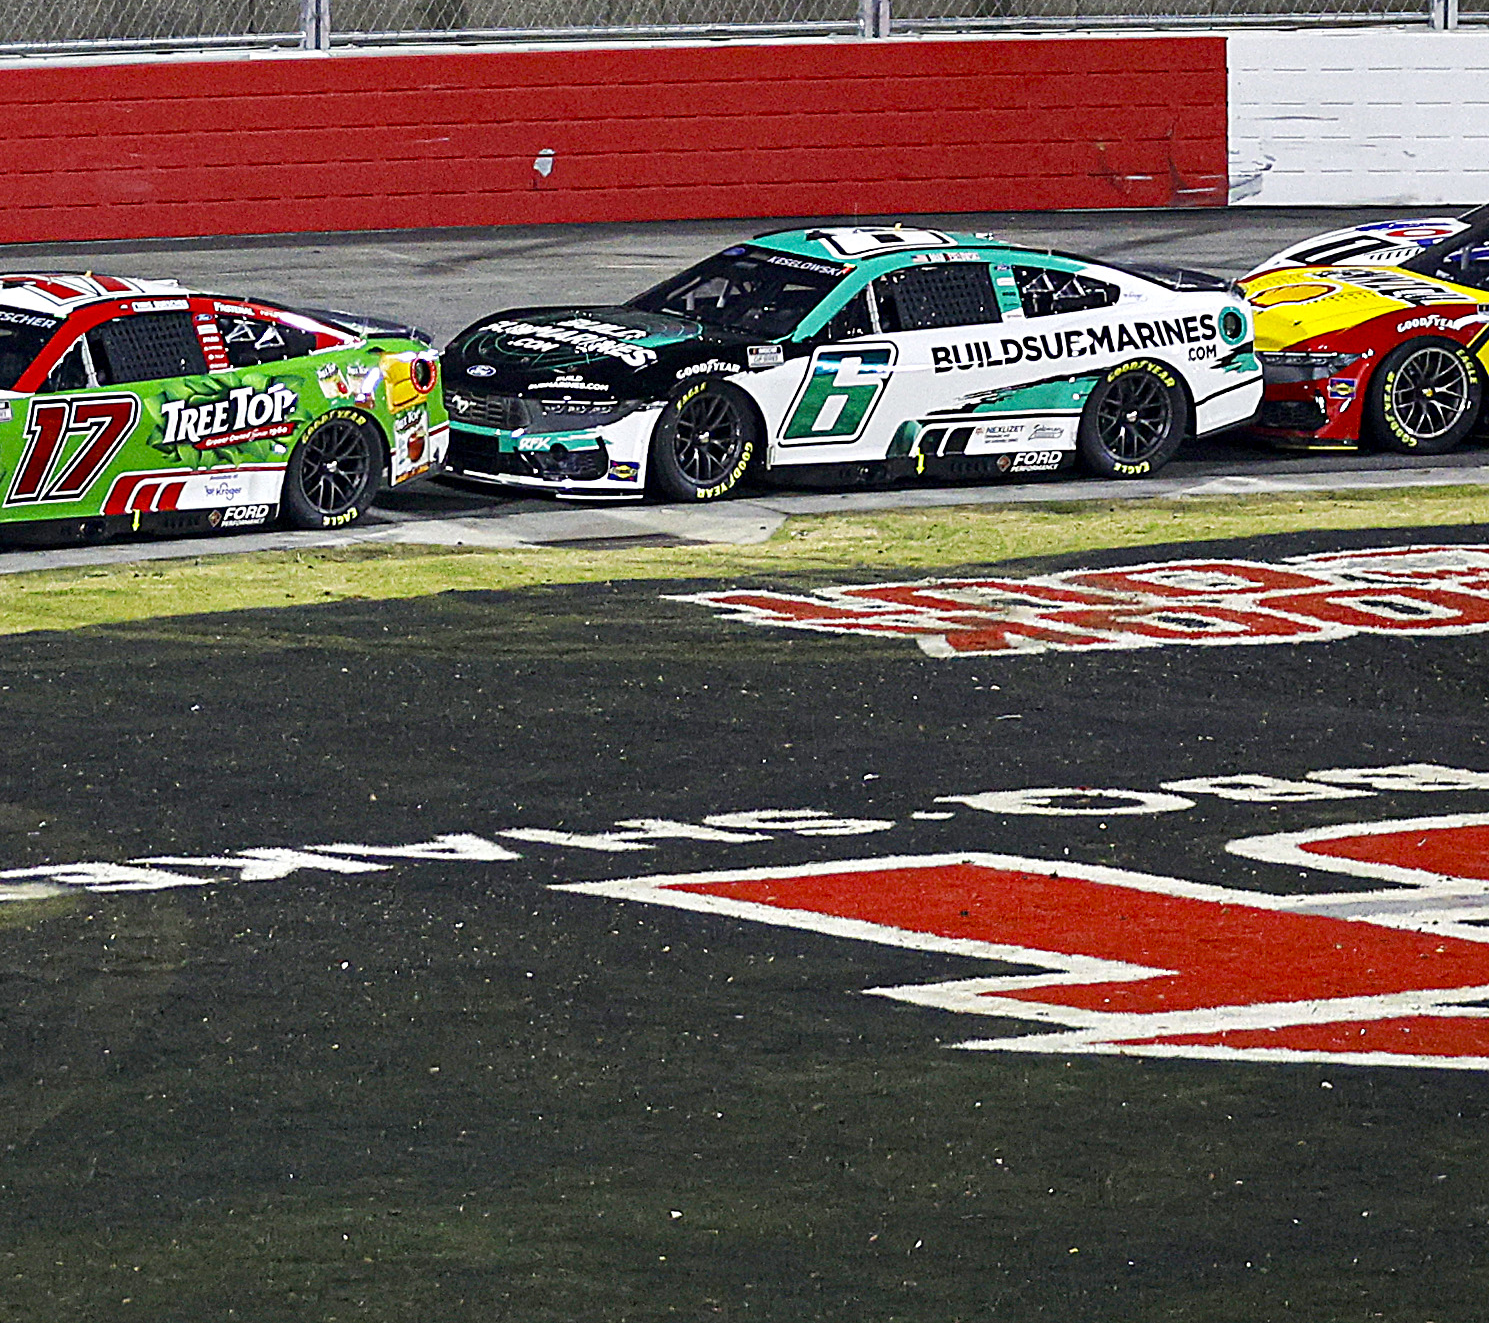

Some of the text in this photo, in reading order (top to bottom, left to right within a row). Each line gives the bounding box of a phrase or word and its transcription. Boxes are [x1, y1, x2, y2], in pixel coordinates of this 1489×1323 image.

[767, 255, 843, 276] KESELOWSKI
[1188, 344, 1217, 362] .COM
[676, 358, 740, 381] GOODYEAR
[783, 348, 892, 439] 6
[161, 383, 292, 444] TREE TOP
[8, 398, 137, 505] 17
[1013, 451, 1063, 465] FORD
[223, 504, 269, 520] FORD
